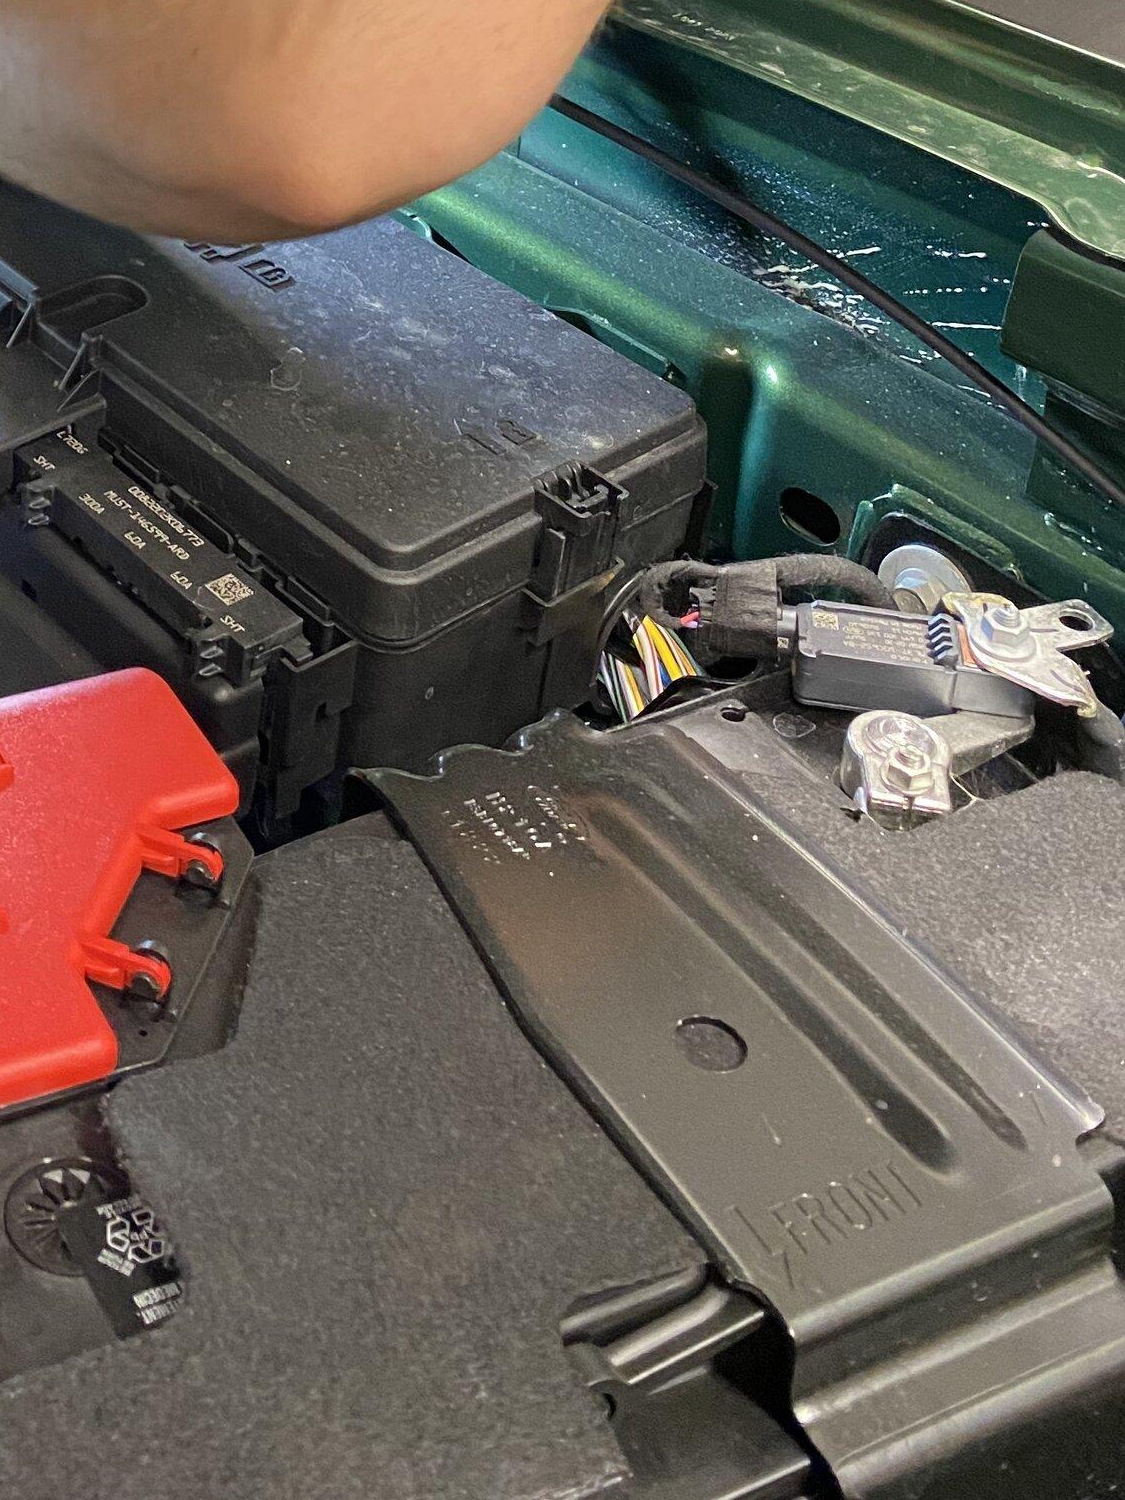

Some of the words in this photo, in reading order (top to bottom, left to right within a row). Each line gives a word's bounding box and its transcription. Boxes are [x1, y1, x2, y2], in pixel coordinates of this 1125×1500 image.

[33, 454, 57, 472] SHT
[78, 492, 106, 516] 300A
[124, 530, 148, 550] 60A
[169, 570, 194, 591] 60A
[219, 613, 246, 634] SHT
